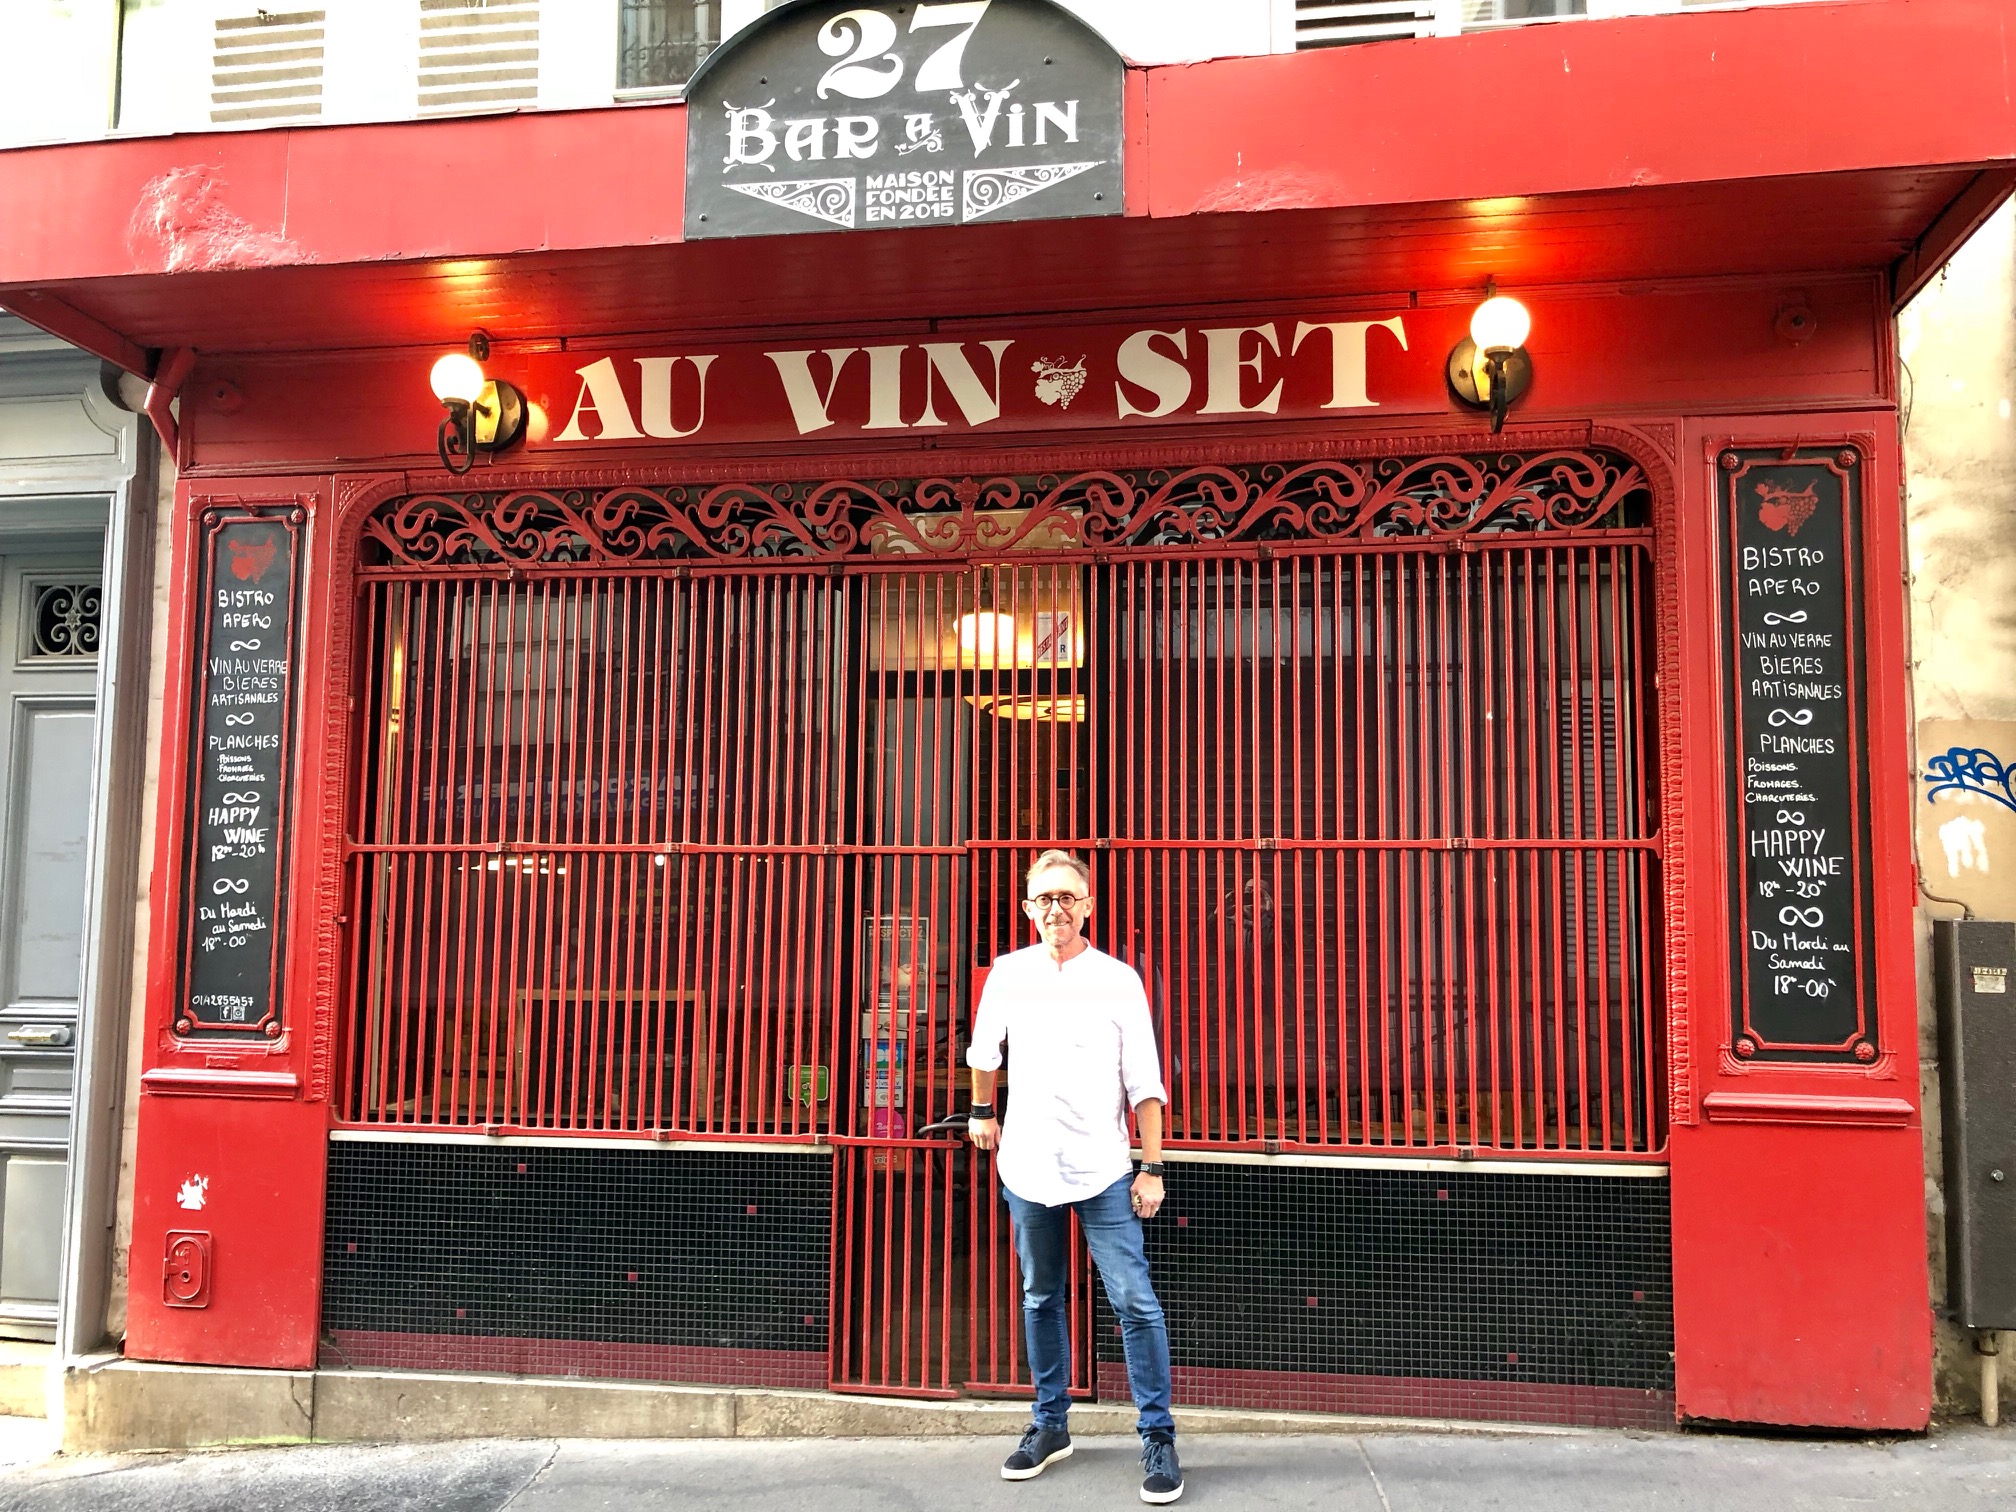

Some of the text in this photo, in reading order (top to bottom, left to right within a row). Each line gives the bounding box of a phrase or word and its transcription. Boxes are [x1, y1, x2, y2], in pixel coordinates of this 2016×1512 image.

[816, 0, 991, 100] 27
[866, 202, 954, 221] EN 2015
[553, 315, 1410, 443] AU VIN SET
[1743, 546, 1824, 570] BISTRO
[1748, 578, 1821, 597] APERO
[218, 589, 274, 607] BISTRO
[222, 613, 271, 629] APERO
[1769, 632, 1787, 648] AU
[1788, 632, 1832, 648] VERRE
[209, 656, 231, 676] VIN
[234, 658, 250, 675] AU
[209, 734, 279, 750] PLANCHES
[1760, 734, 1835, 754] PLANCHES
[208, 806, 260, 826] HAPPY
[223, 827, 269, 844] WINE
[1751, 828, 1825, 857] HAPPY
[1778, 856, 1844, 877] WINE
[199, 901, 258, 921] Du Mardi
[212, 916, 267, 934] au Samedi
[1751, 930, 1850, 952] Du Mardi au
[1768, 953, 1826, 970] Samedi
